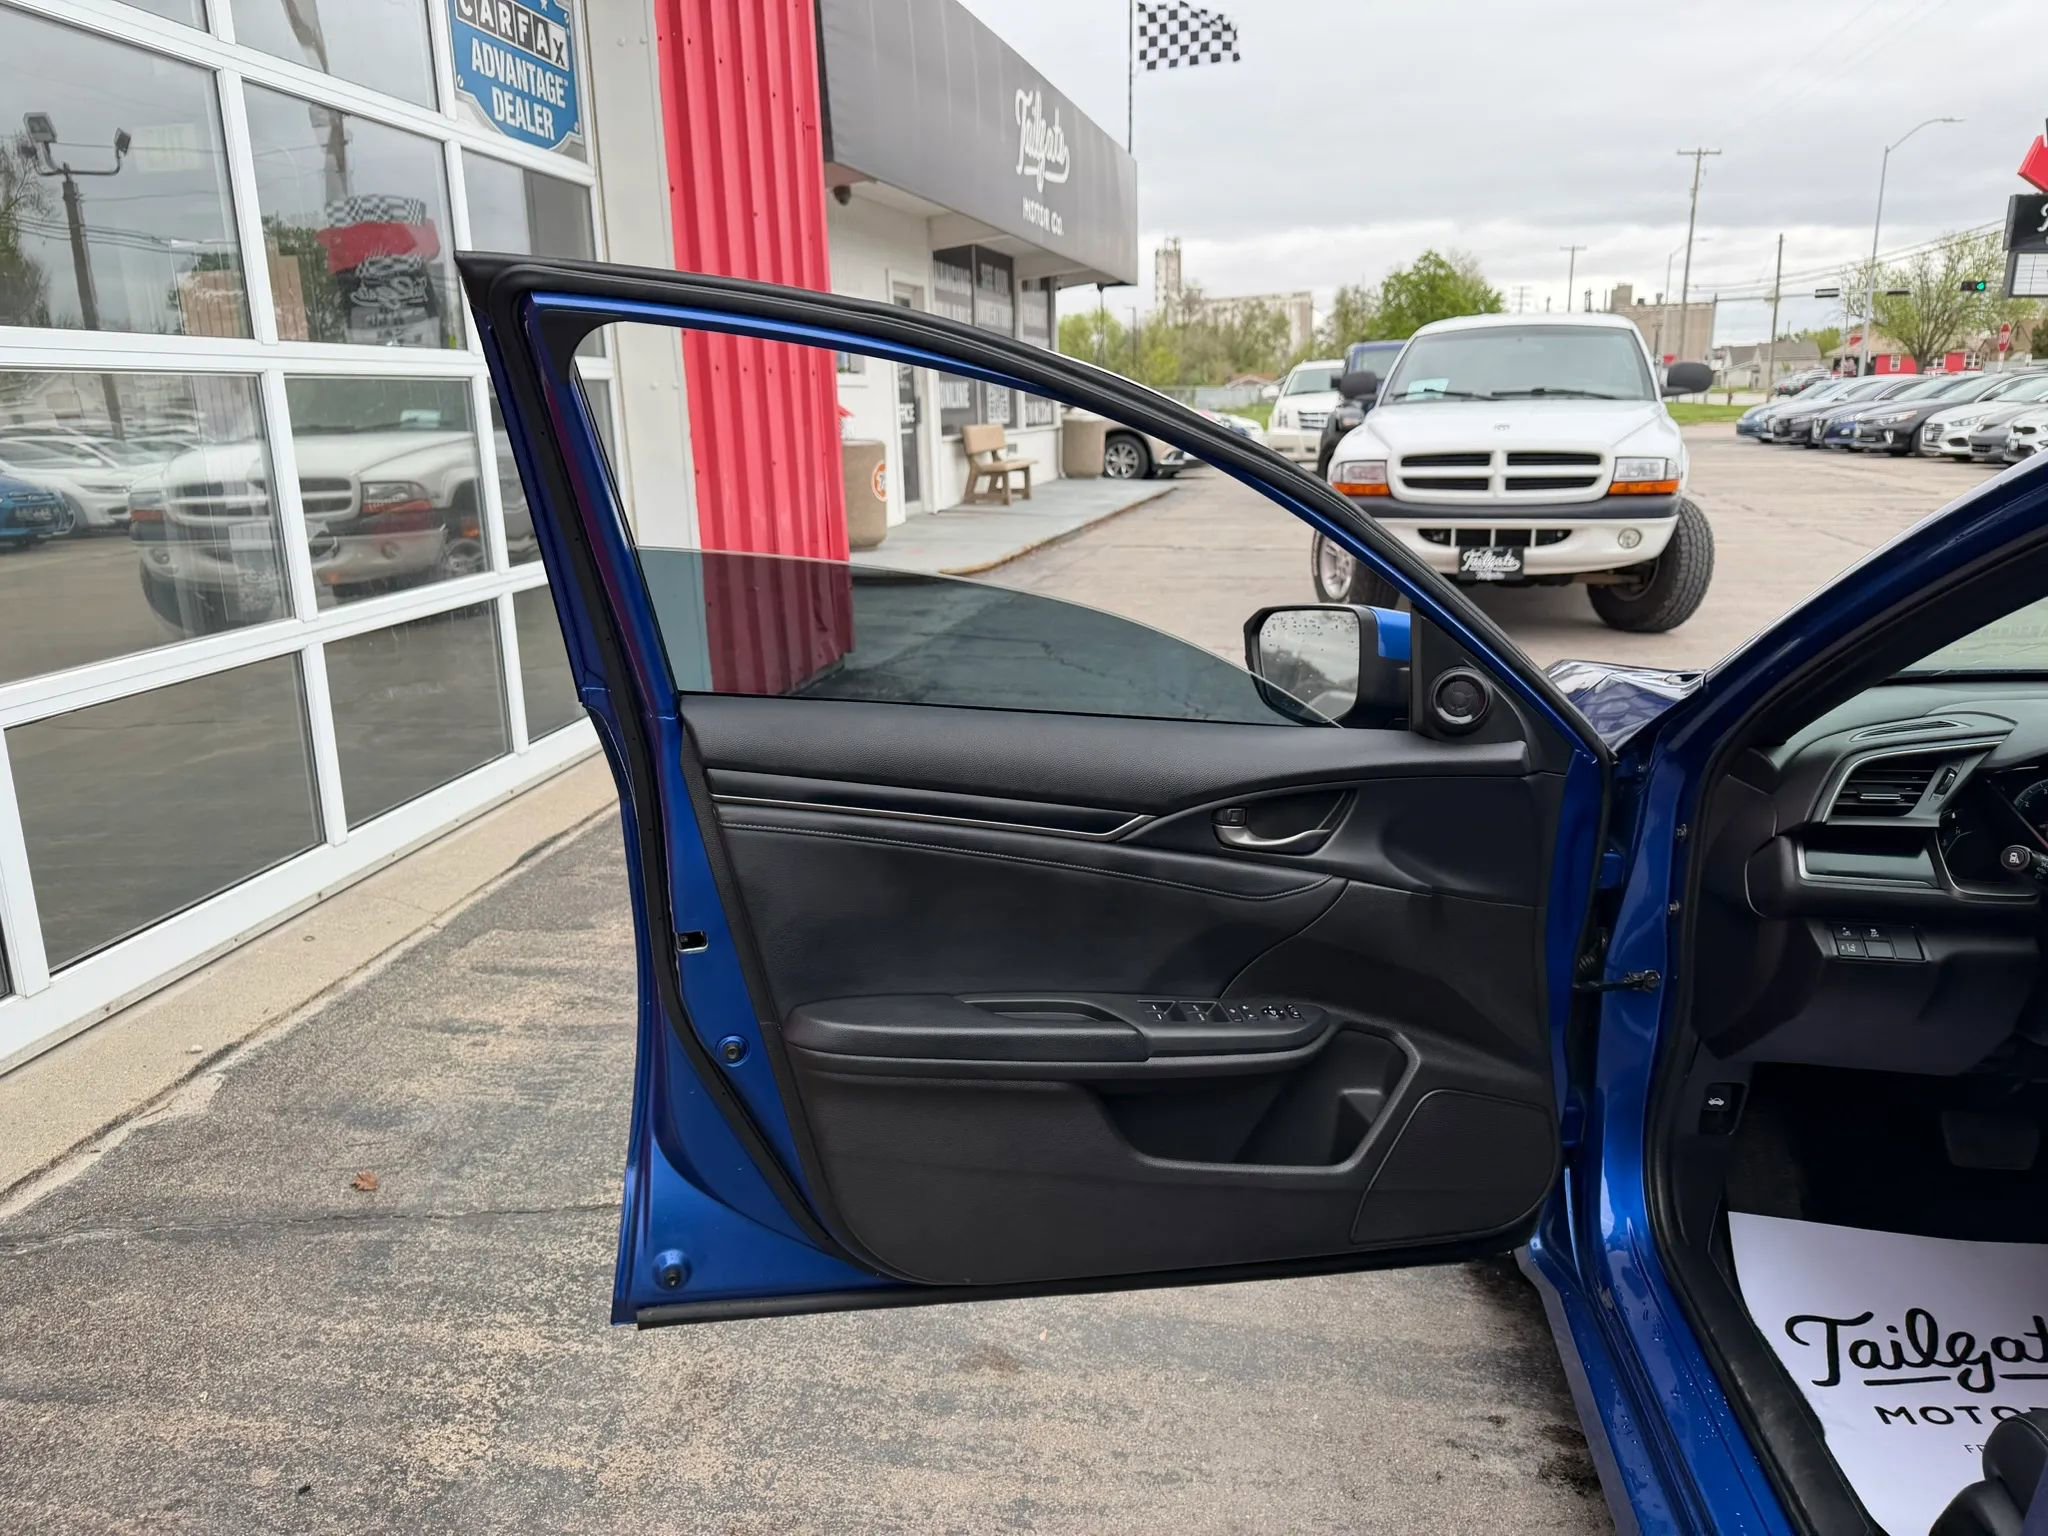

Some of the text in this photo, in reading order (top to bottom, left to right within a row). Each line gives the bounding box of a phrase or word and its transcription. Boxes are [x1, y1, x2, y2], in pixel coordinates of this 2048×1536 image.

[459, 0, 565, 66] CARFAX
[472, 37, 566, 109] ADVANTAGE
[491, 86, 555, 141] DEALER
[1015, 88, 1070, 193] Tailgate
[1785, 1307, 2048, 1394] Tailgat
[1873, 1405, 2048, 1425] MOTO
